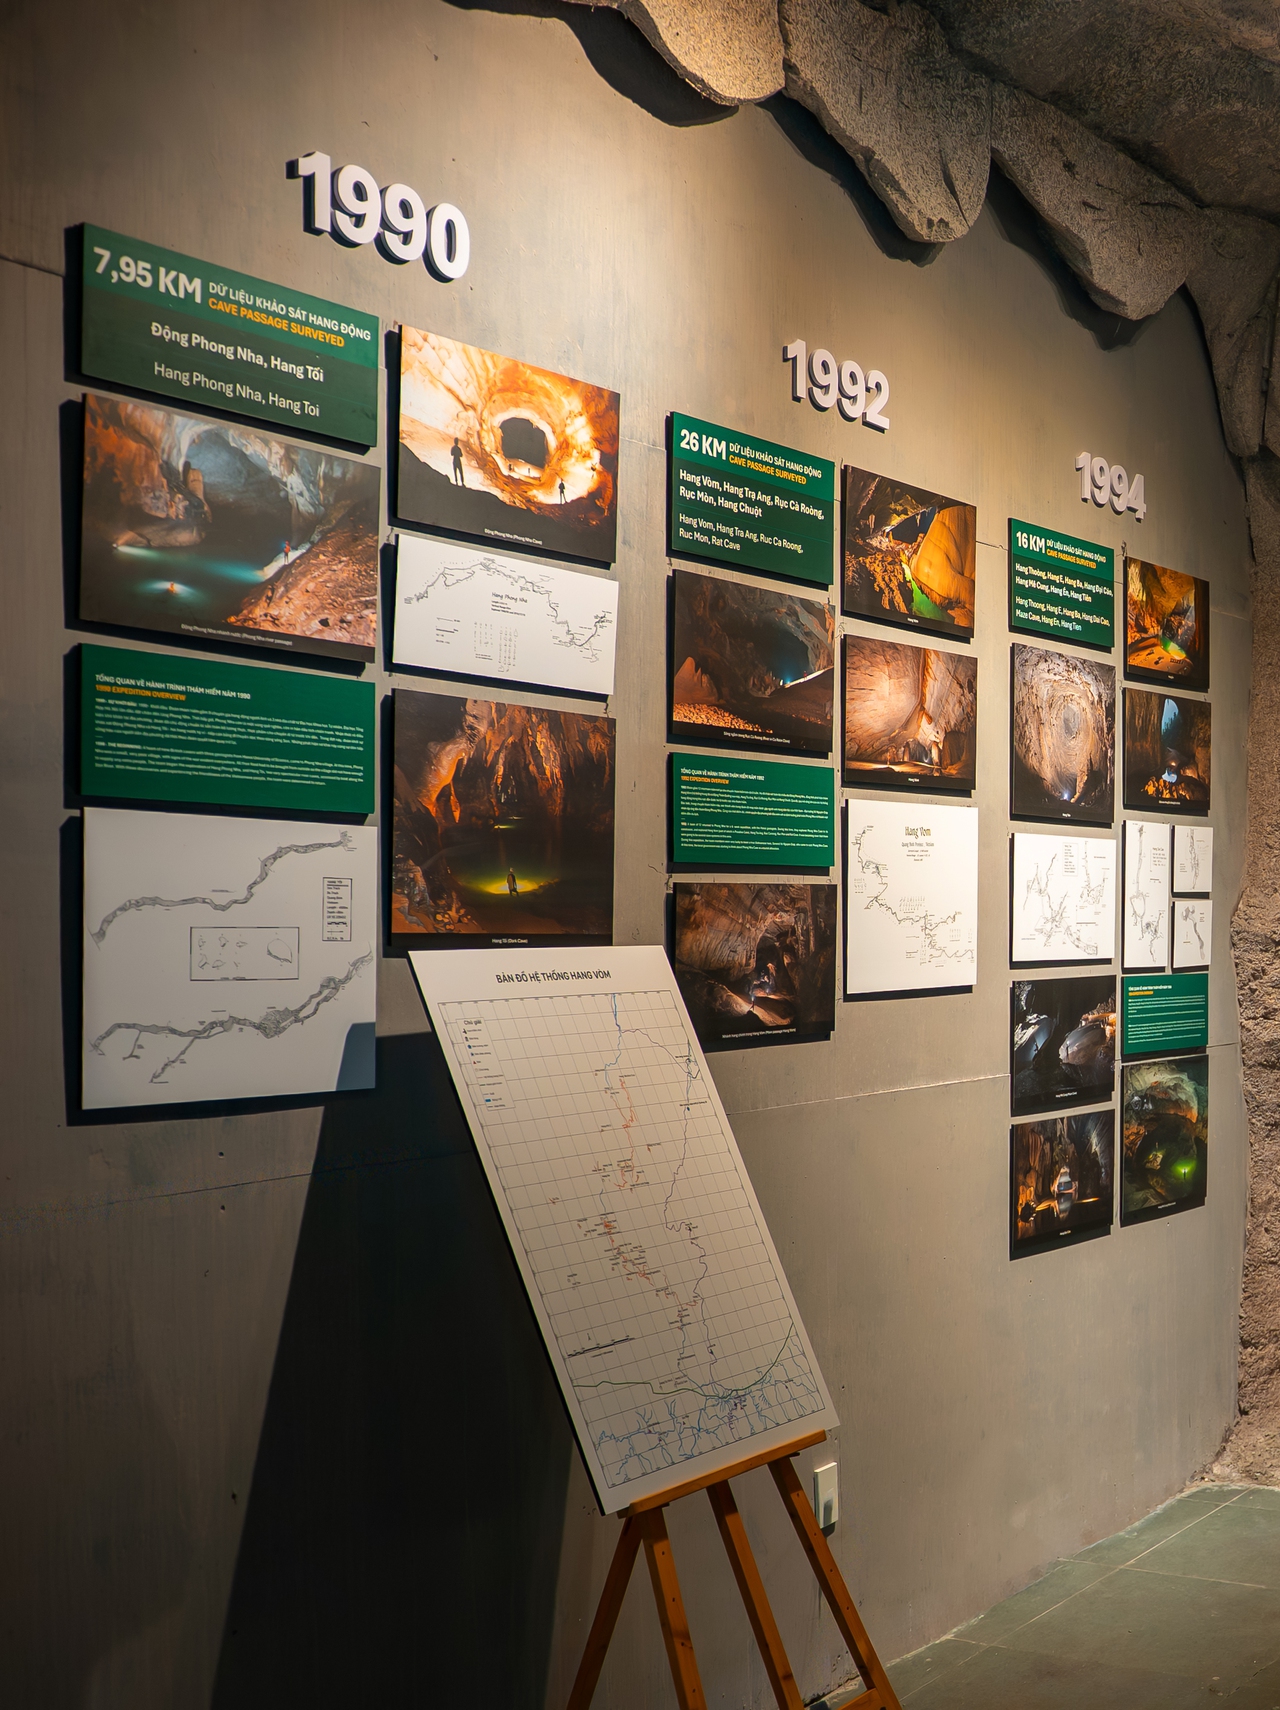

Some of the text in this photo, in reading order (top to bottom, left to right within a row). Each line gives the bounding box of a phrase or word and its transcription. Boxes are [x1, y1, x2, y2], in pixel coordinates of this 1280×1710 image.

[292, 151, 470, 281] 1990
[94, 247, 201, 304] 7,95 KM
[208, 298, 345, 347] CAVE PASSAGE SURVEYED
[209, 282, 371, 341] DỮ LIỆU KHẢO SÁT HANG ĐỘNG
[151, 322, 324, 382] Động Phong Nha, Hang Tối
[154, 362, 319, 417] Hang Phong Nha, Hang Toi
[785, 338, 889, 432] 1992
[680, 429, 726, 460] 26 KM
[729, 443, 741, 452] DỮ
[741, 445, 754, 459] LIỆU
[774, 456, 785, 466] SÁT
[786, 461, 803, 472] HANG
[804, 465, 822, 478] ĐỘNG
[680, 469, 700, 486] Hang
[702, 475, 722, 492] Vòm,
[724, 481, 743, 498] Hang
[757, 491, 773, 506] Ang,
[774, 496, 788, 509] Rục
[729, 455, 806, 485] CAVE PASSAGE SURVEYED
[1075, 451, 1146, 521] 1994
[680, 486, 695, 500] Rục
[718, 496, 738, 513] Hang
[680, 513, 803, 554] Hang Vom, Hang Tra Ang, Ruc Ca Roong,
[680, 528, 740, 550] Ruc Mon, Rat Cave
[1016, 531, 1045, 553] 16 KM
[529, 971, 541, 983] HỆ
[570, 971, 592, 980] HANG
[593, 969, 611, 978] VÒM
